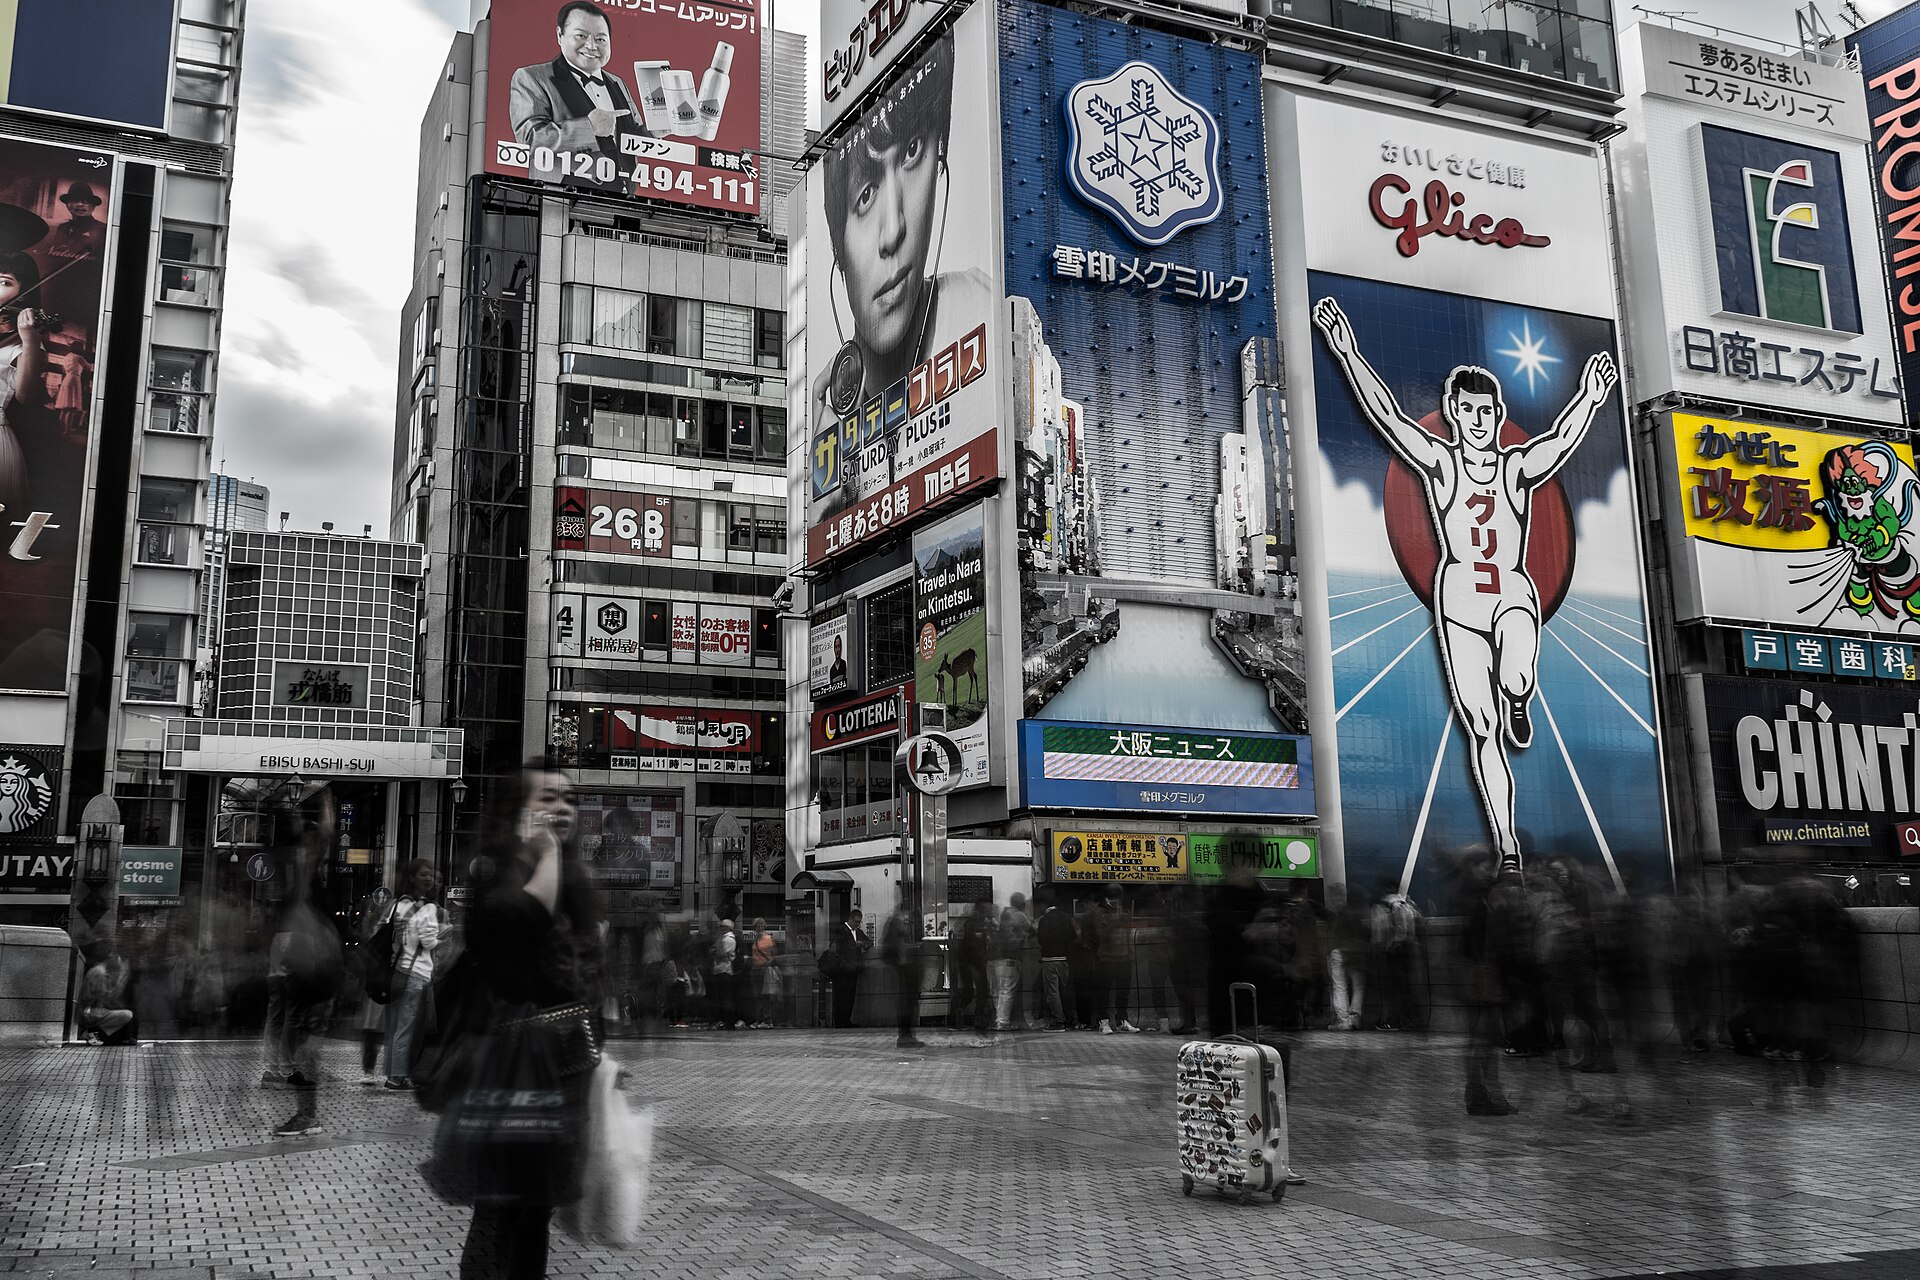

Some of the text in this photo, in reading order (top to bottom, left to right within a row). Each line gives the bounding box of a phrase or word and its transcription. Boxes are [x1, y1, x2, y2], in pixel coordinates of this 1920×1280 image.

[1699, 43, 1812, 87] 夢ある住まい
[1684, 73, 1835, 126] エステムシリーズ
[625, 138, 671, 155] ルアン
[1381, 140, 1527, 189] おいしさと健康
[534, 146, 755, 205] 0120-494-111
[1368, 173, 1552, 258] Glico
[1052, 244, 1249, 303] 雪印メグミルク
[1683, 324, 1901, 400] 日商エステム
[814, 333, 983, 490] サタデープラス
[842, 411, 937, 486] SATURDAY PLUS
[1695, 424, 1800, 469] かぜに
[656, 498, 670, 506] 5F
[1688, 466, 1817, 532] 改源
[590, 505, 664, 540] 268
[825, 484, 910, 556] 土曜あさ8時
[1464, 489, 1502, 595] グリコ
[918, 558, 981, 596] Travel to Nara
[918, 608, 927, 620] on
[928, 587, 973, 617] Kintetsu.
[557, 606, 574, 644] 4F
[588, 636, 638, 654] 相席屋
[303, 667, 342, 682] なんば
[838, 698, 898, 734] LOTTERIA
[260, 755, 301, 768] EBISU
[1109, 730, 1235, 759] 大阪ニュース
[1735, 688, 1920, 814] CHINT
[1139, 790, 1206, 804] 雪印メグミルク
[1087, 838, 1157, 852] 店舗情報館
[123, 872, 164, 884] store
